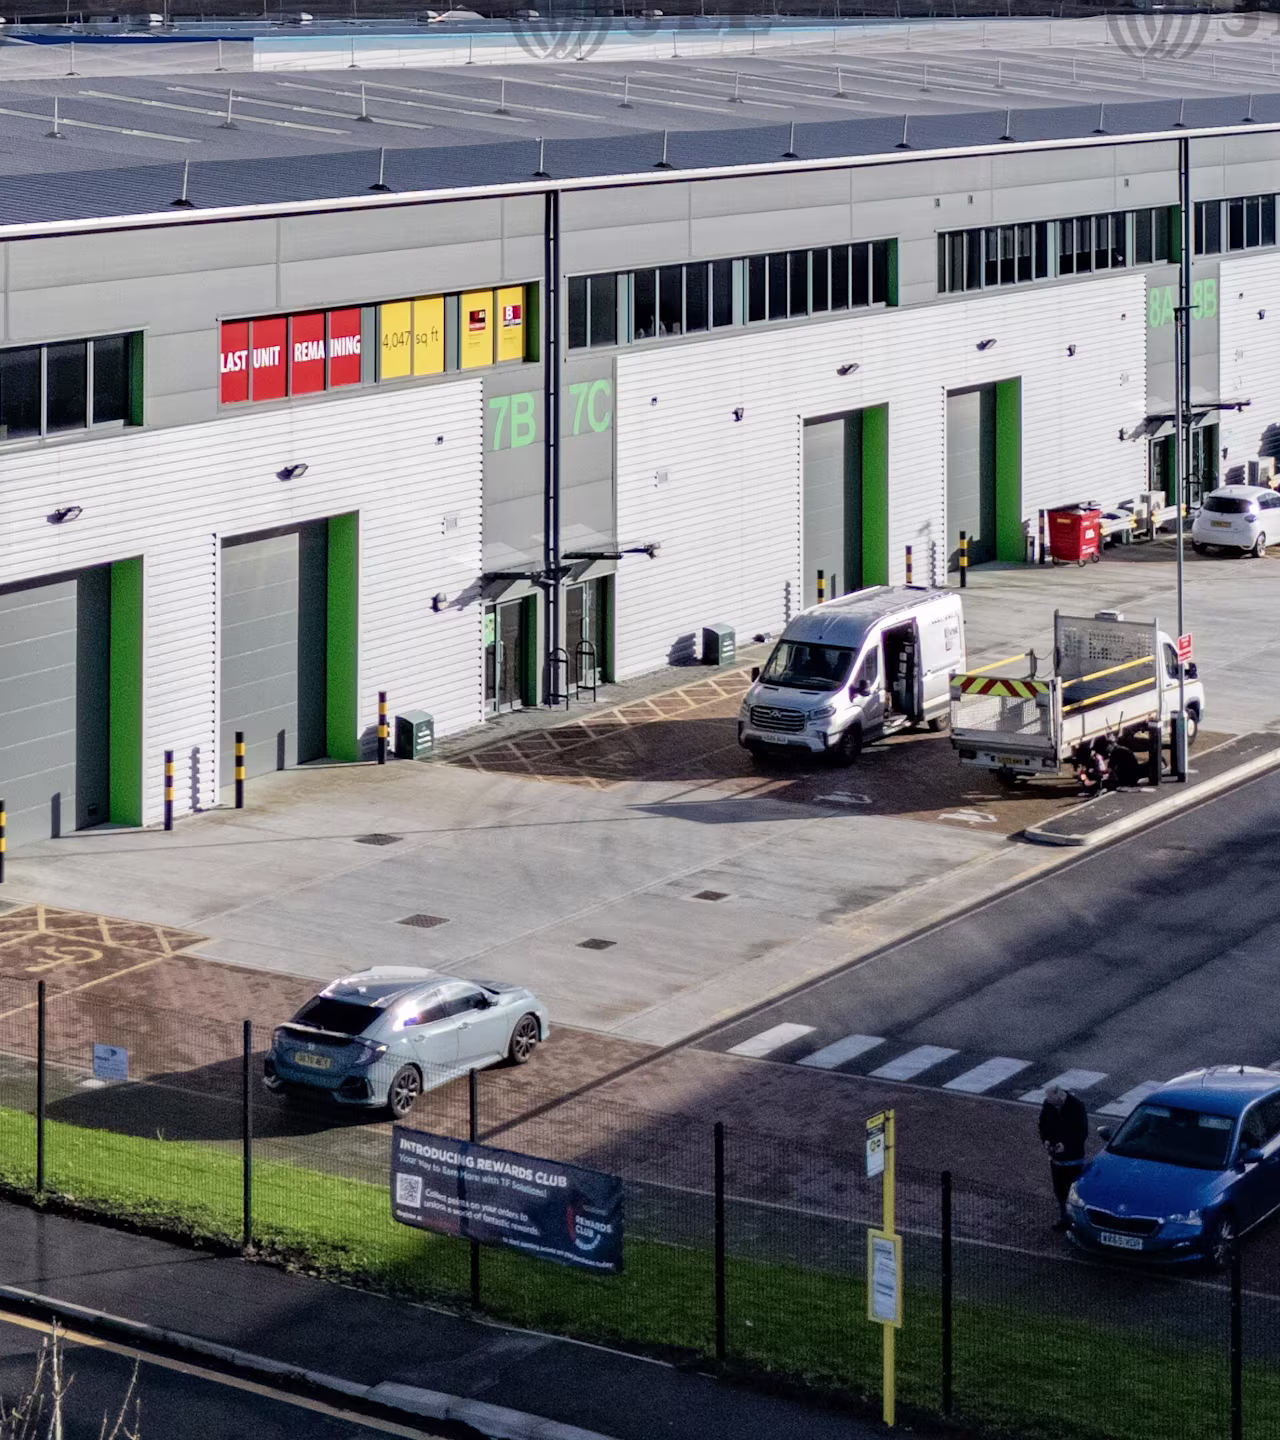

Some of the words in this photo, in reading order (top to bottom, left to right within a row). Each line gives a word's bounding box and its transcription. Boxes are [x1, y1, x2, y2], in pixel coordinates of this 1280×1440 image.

[1150, 286, 1175, 328] 8A
[1193, 278, 1217, 320] 8B
[220, 350, 248, 373] LAST
[253, 345, 281, 368] UNIT
[294, 334, 362, 362] REMAINING
[383, 330, 412, 351] 4,047
[416, 333, 428, 347] sq
[431, 326, 439, 343] ft
[489, 392, 536, 450] 7B
[569, 379, 612, 435] 7C
[399, 1153, 417, 1164] Your
[433, 1164, 441, 1172] to
[442, 1166, 459, 1178] Earn
[482, 1175, 499, 1185] with
[501, 1177, 511, 1187] TF
[400, 1138, 475, 1168] INTRODUCING
[476, 1158, 533, 1181] REWARDS
[535, 1171, 567, 1188] CLUB
[473, 1212, 482, 1220] of
[481, 1204, 497, 1214] your
[497, 1208, 519, 1220] orders
[520, 1214, 528, 1222] to
[575, 1215, 612, 1233] REWARDS
[575, 1224, 594, 1238] CLUB
